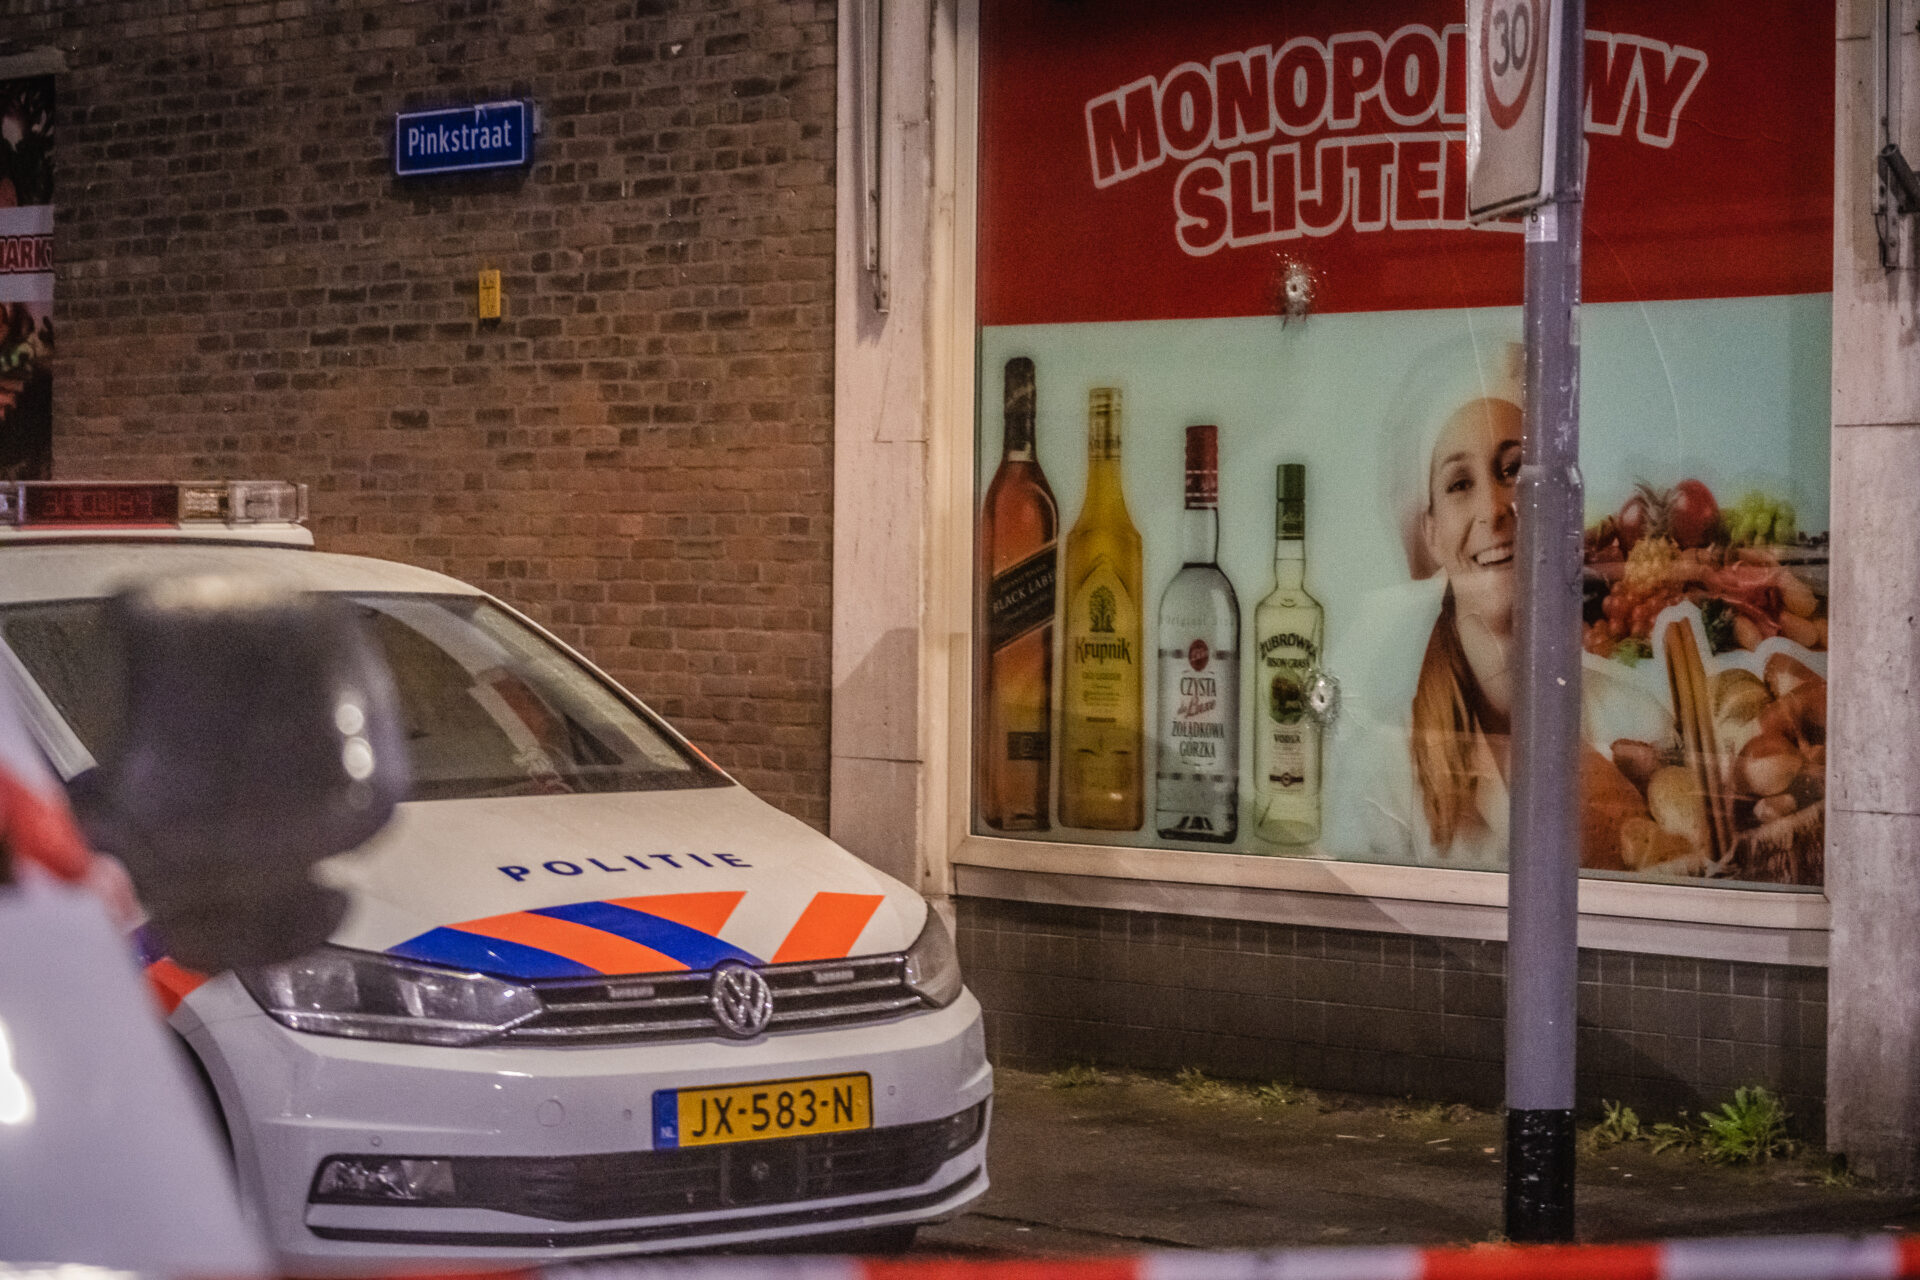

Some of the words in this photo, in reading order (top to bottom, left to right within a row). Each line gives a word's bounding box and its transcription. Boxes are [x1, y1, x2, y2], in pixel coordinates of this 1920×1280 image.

[1493, 4, 1530, 77] 30
[1086, 24, 1708, 190] MONOPOLWY
[408, 119, 512, 157] Pinkstraat
[992, 590, 1027, 615] BLACK
[1074, 636, 1132, 665] Krupnik
[1180, 677, 1217, 697] CZYSTA
[497, 853, 752, 882] POLITIE
[692, 1085, 854, 1138] JX-583-N
